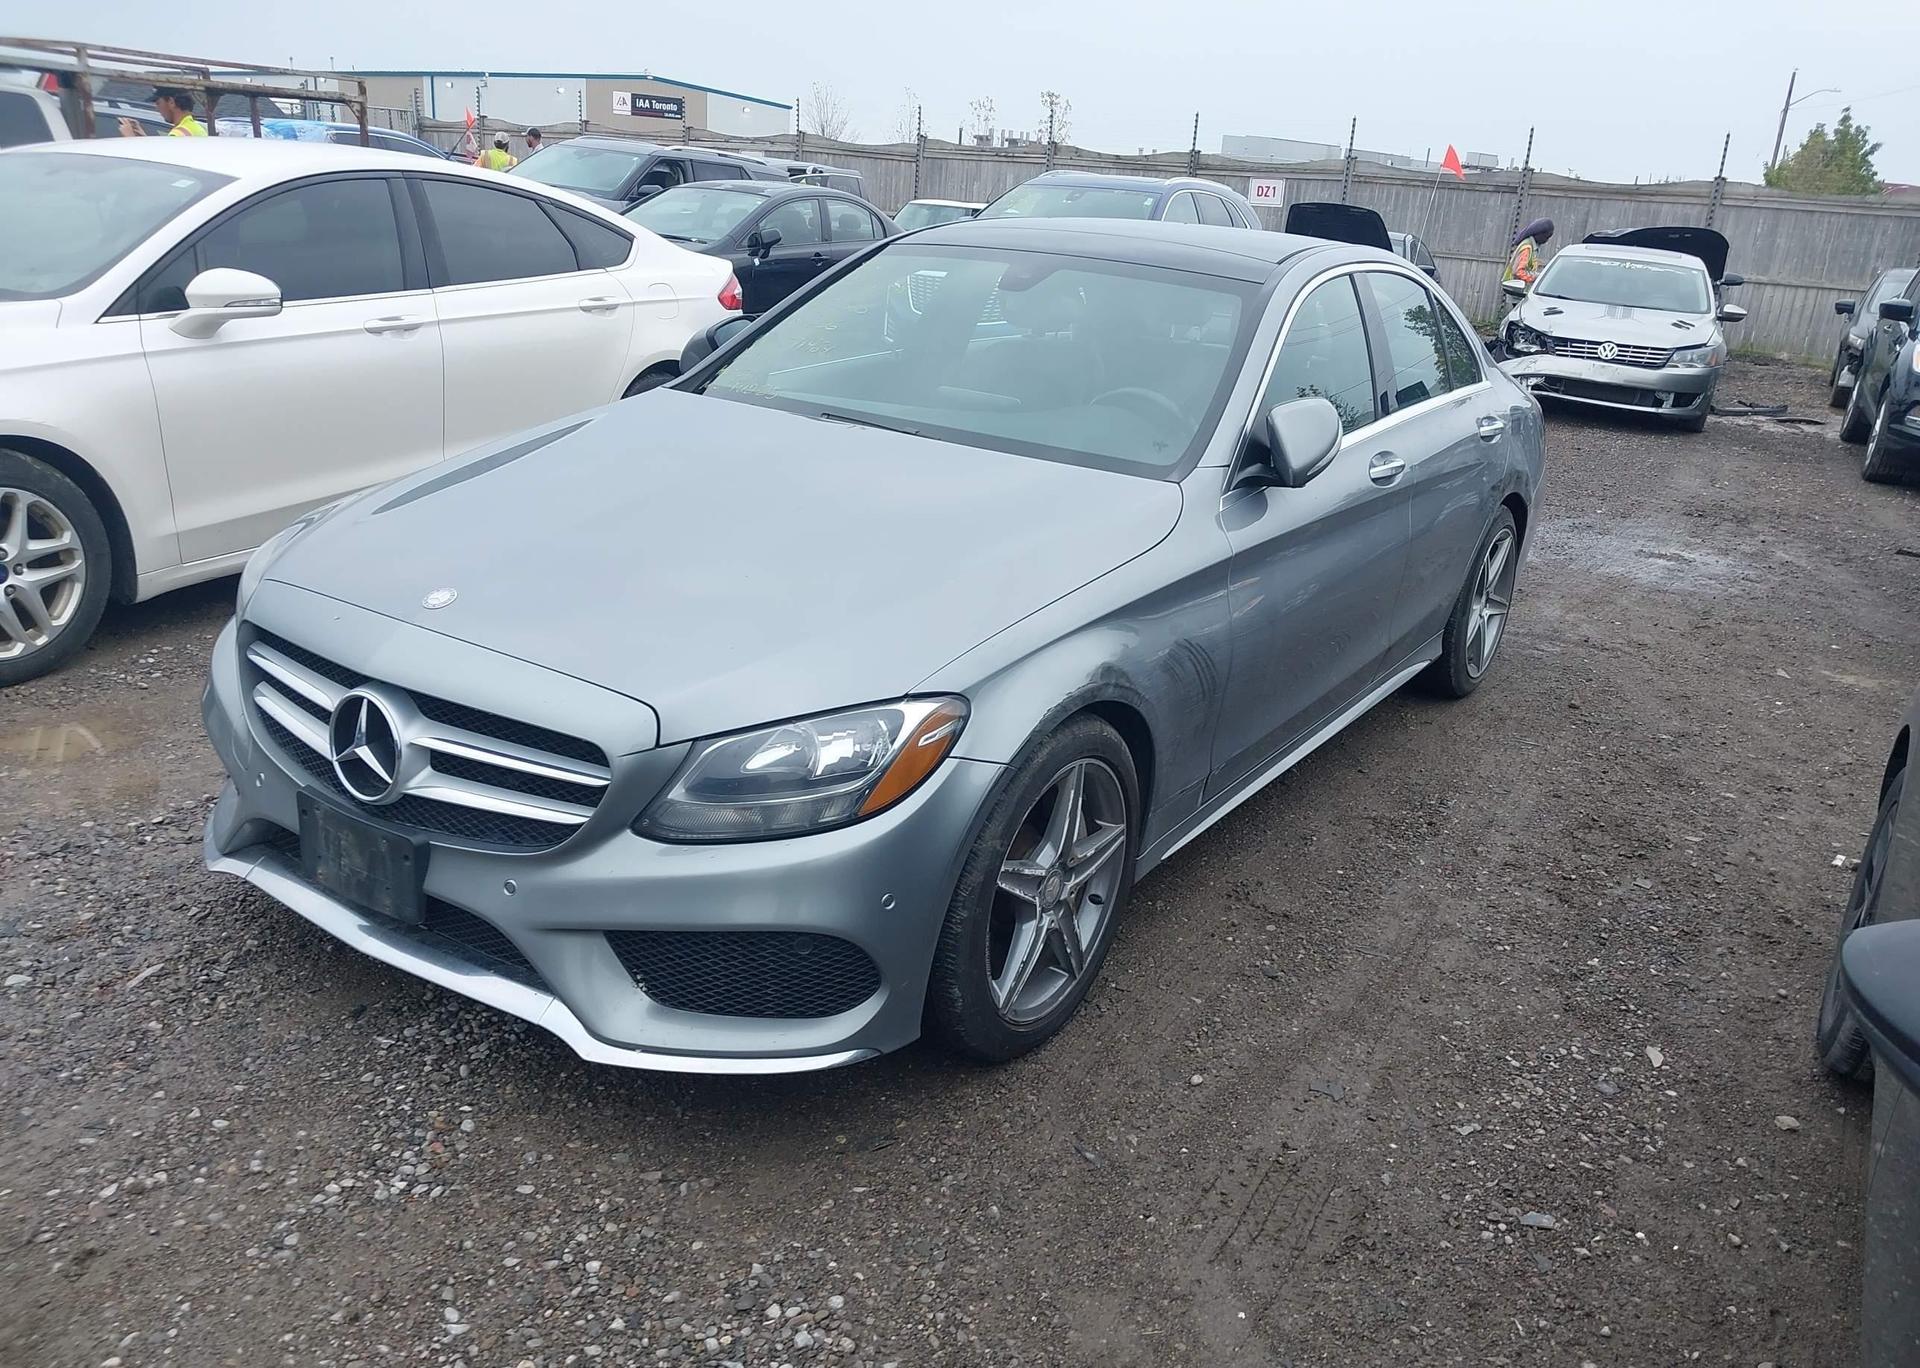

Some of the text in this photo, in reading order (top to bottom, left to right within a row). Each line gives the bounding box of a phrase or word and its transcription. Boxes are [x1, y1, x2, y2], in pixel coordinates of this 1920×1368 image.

[635, 98, 678, 111] IAA Toronto
[1256, 185, 1277, 198] DZ1
